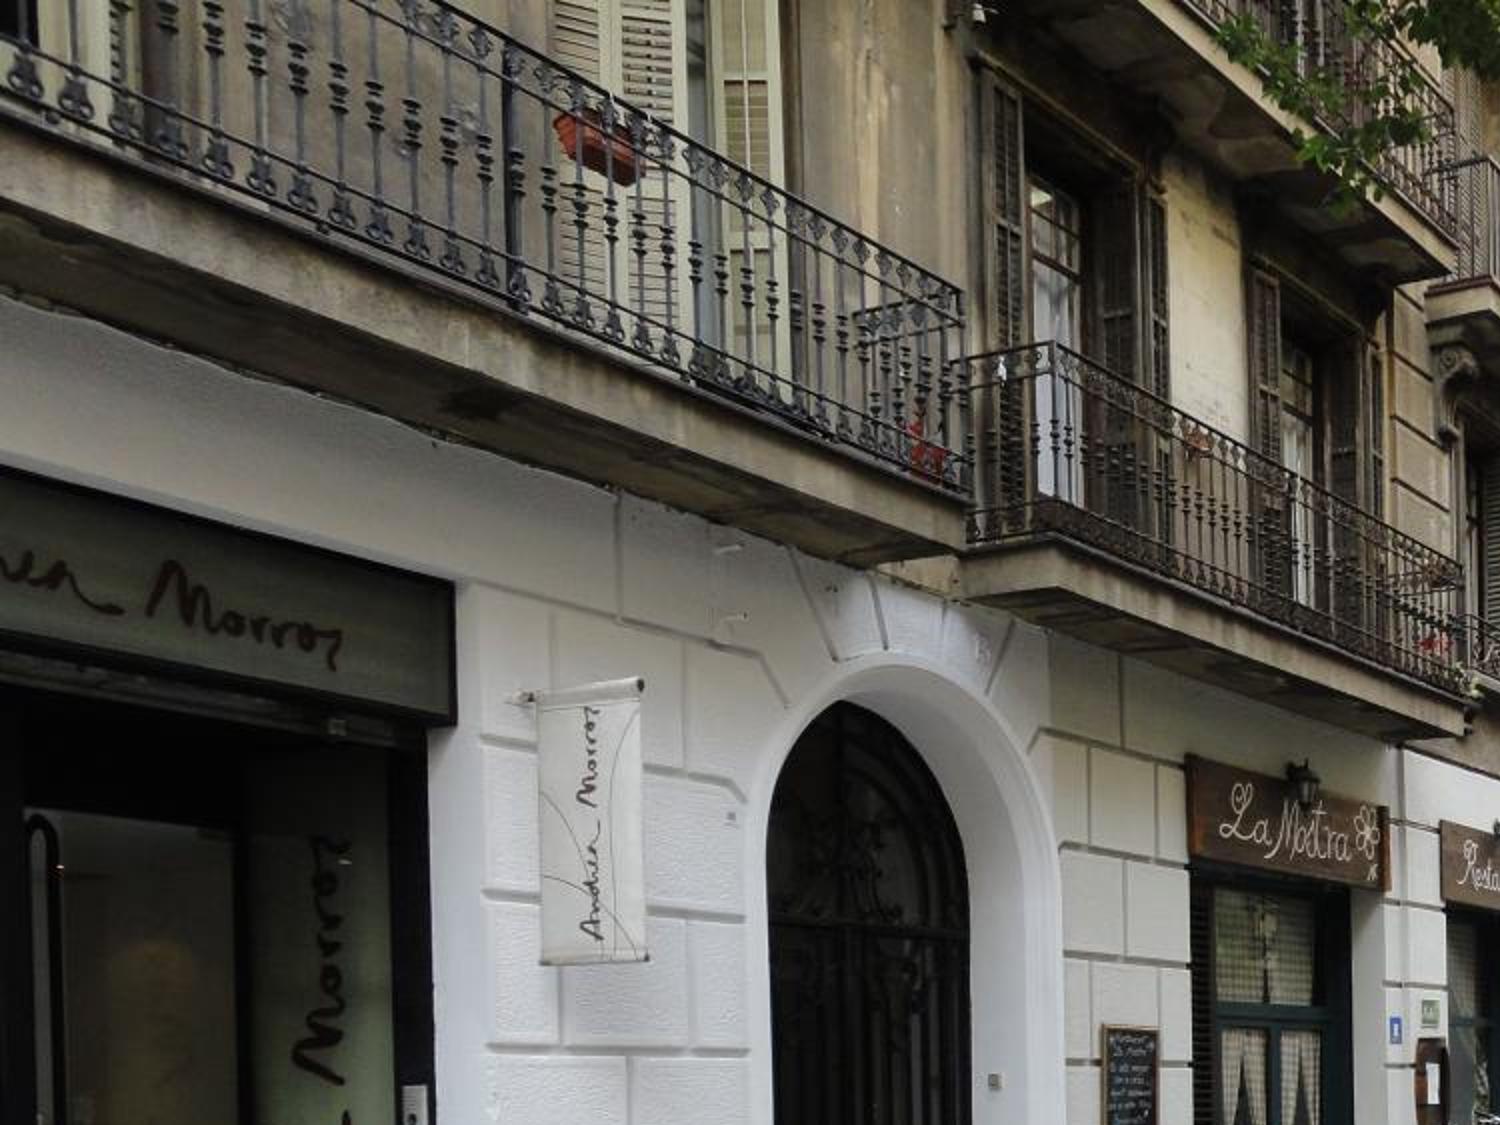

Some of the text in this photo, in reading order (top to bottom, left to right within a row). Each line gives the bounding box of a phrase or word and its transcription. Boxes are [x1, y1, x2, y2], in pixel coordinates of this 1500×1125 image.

[1219, 783, 1352, 862] La Mostra
[579, 819, 605, 941] Andrea
